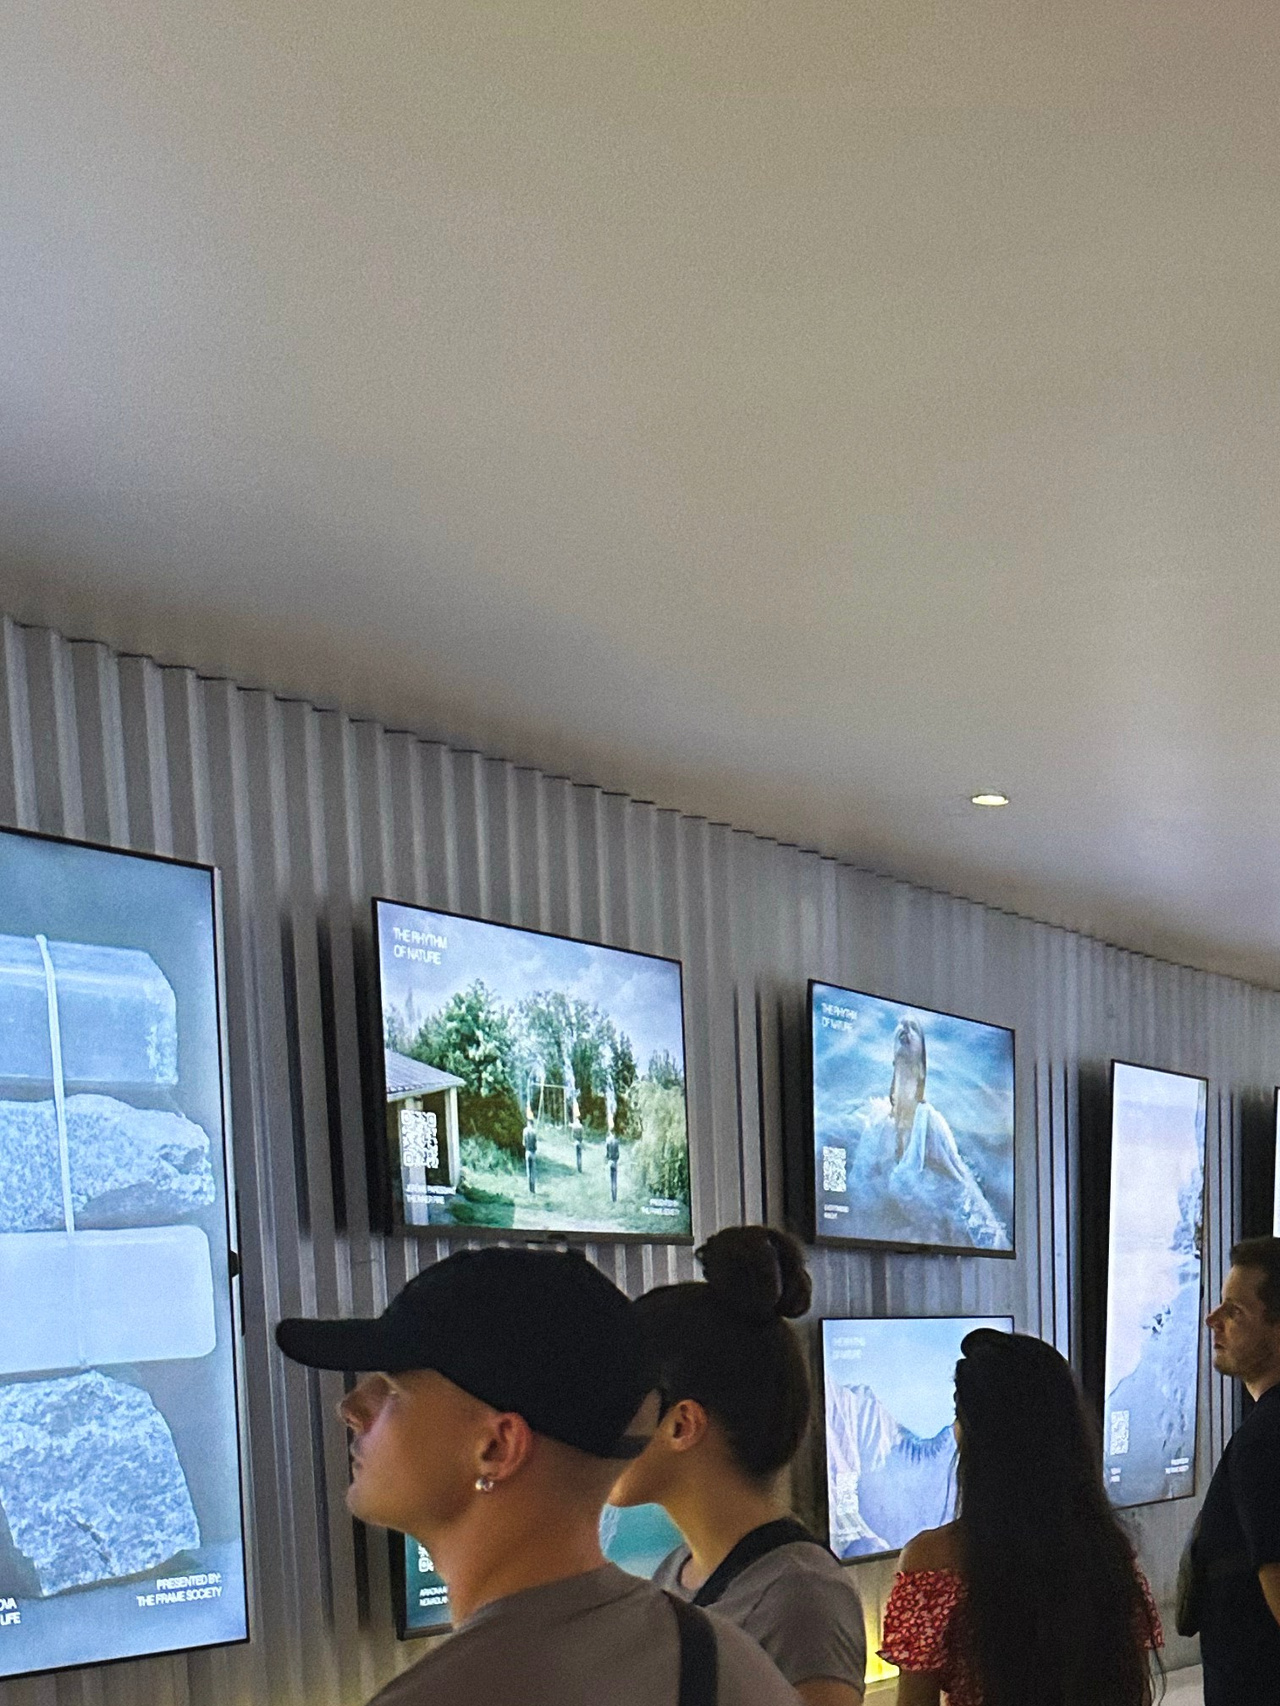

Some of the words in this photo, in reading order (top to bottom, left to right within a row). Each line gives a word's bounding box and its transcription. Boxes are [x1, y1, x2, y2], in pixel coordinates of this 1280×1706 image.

[392, 926, 411, 943] THE
[411, 930, 448, 949] RHYTHM
[393, 944, 407, 958] OF
[407, 947, 442, 965] NATURE
[156, 1574, 207, 1591] PRESENTED
[207, 1572, 222, 1586] BY:
[136, 1593, 156, 1607] THE
[156, 1591, 186, 1605] FRAME
[185, 1586, 223, 1602] SOCIETY
[0, 1611, 21, 1626] LIFE
